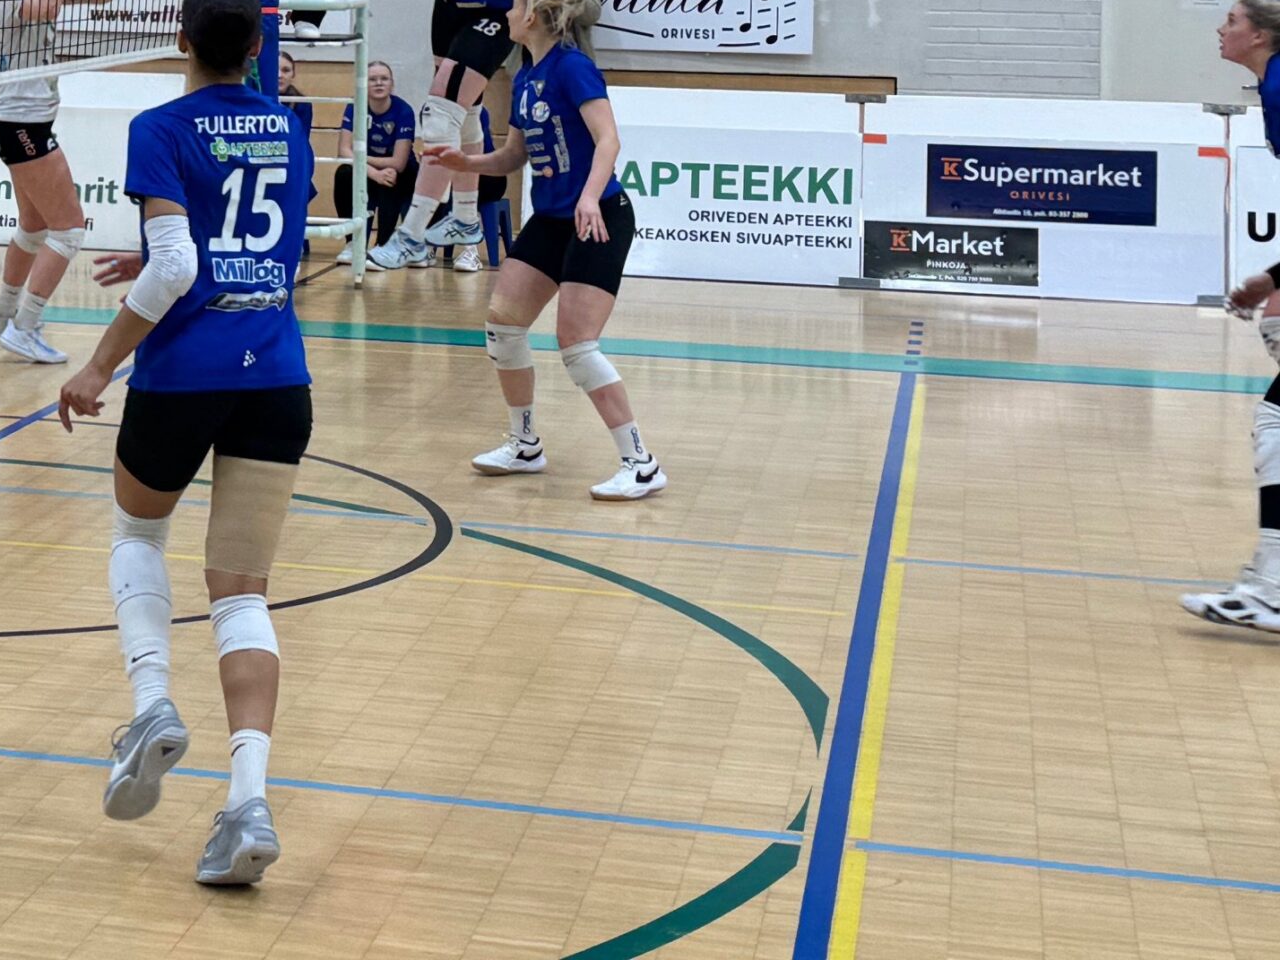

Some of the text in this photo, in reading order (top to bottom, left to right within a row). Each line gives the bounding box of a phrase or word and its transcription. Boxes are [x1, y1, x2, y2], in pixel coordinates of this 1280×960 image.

[472, 18, 502, 37] 18
[661, 27, 716, 40] ORIVESI
[194, 114, 290, 135] FULLERTON
[619, 160, 854, 205] APTEEKKI
[963, 157, 1142, 189] Supermarket
[1009, 189, 1071, 202] ORIVESI
[208, 167, 288, 253] 15
[688, 209, 853, 228] ORIVEDEN APTEEKKI
[1247, 211, 1276, 243] U
[736, 231, 852, 249] SIVUAPTEEKKI
[912, 230, 1004, 257] Market
[211, 256, 286, 288] Millog
[926, 258, 967, 270] PINKOJA
